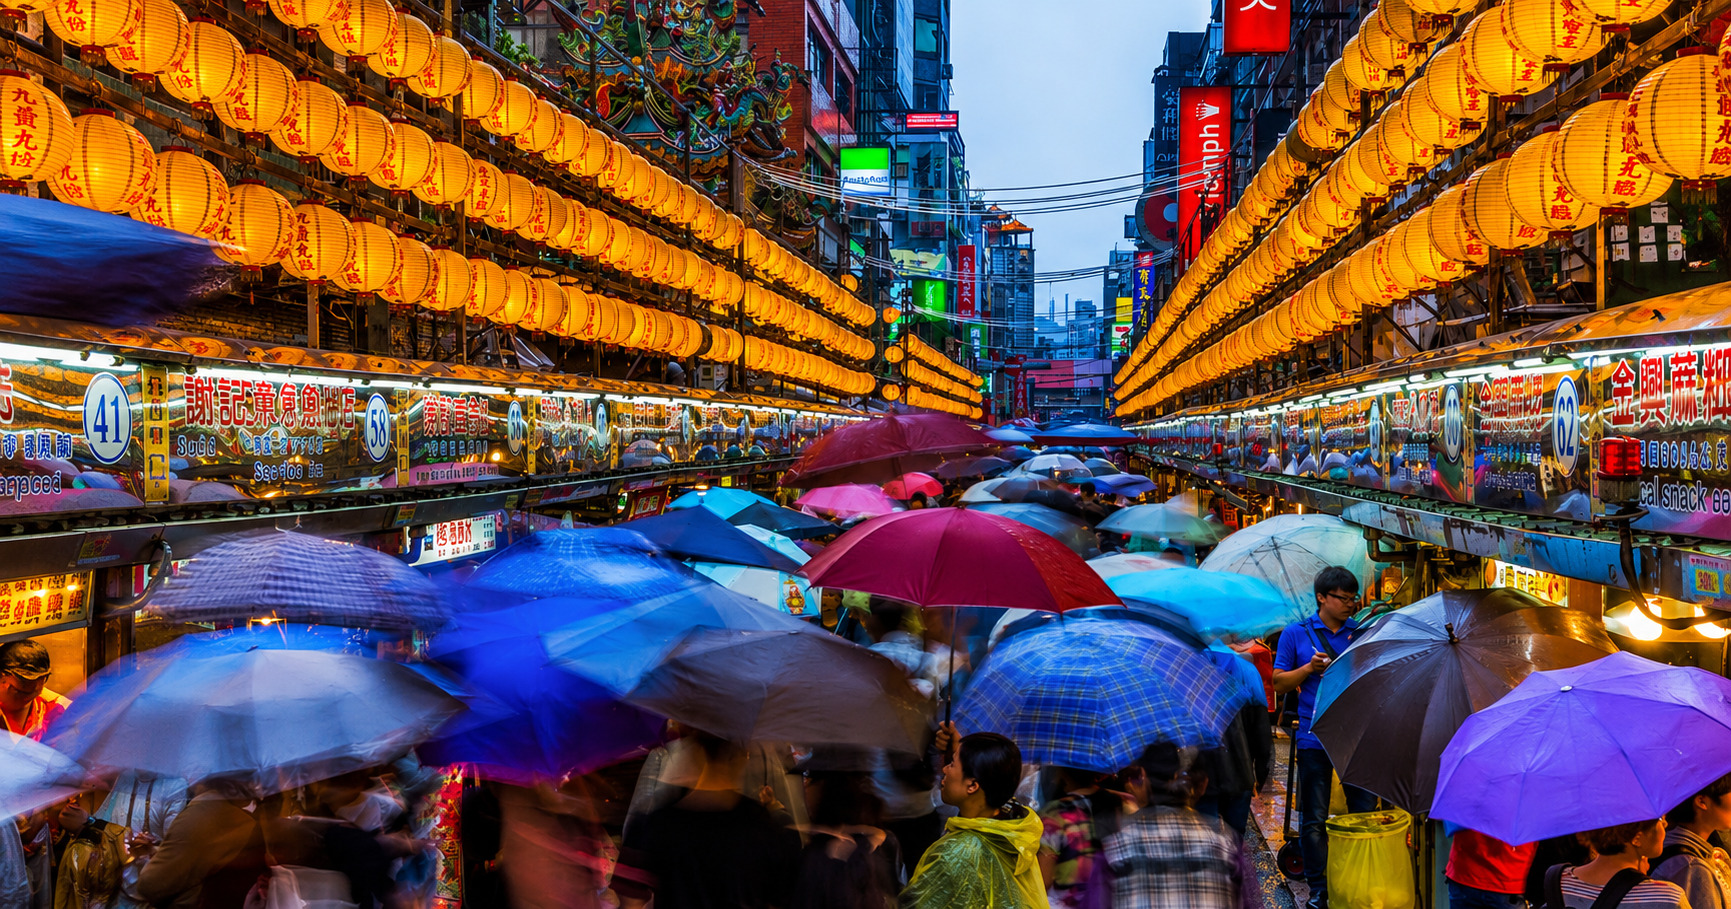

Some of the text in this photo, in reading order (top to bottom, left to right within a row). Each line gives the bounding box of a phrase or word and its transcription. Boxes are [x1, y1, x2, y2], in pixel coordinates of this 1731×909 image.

[93, 394, 122, 443] 41
[370, 409, 387, 448] 58
[1557, 396, 1575, 456] 62
[1662, 481, 1707, 513] snack
